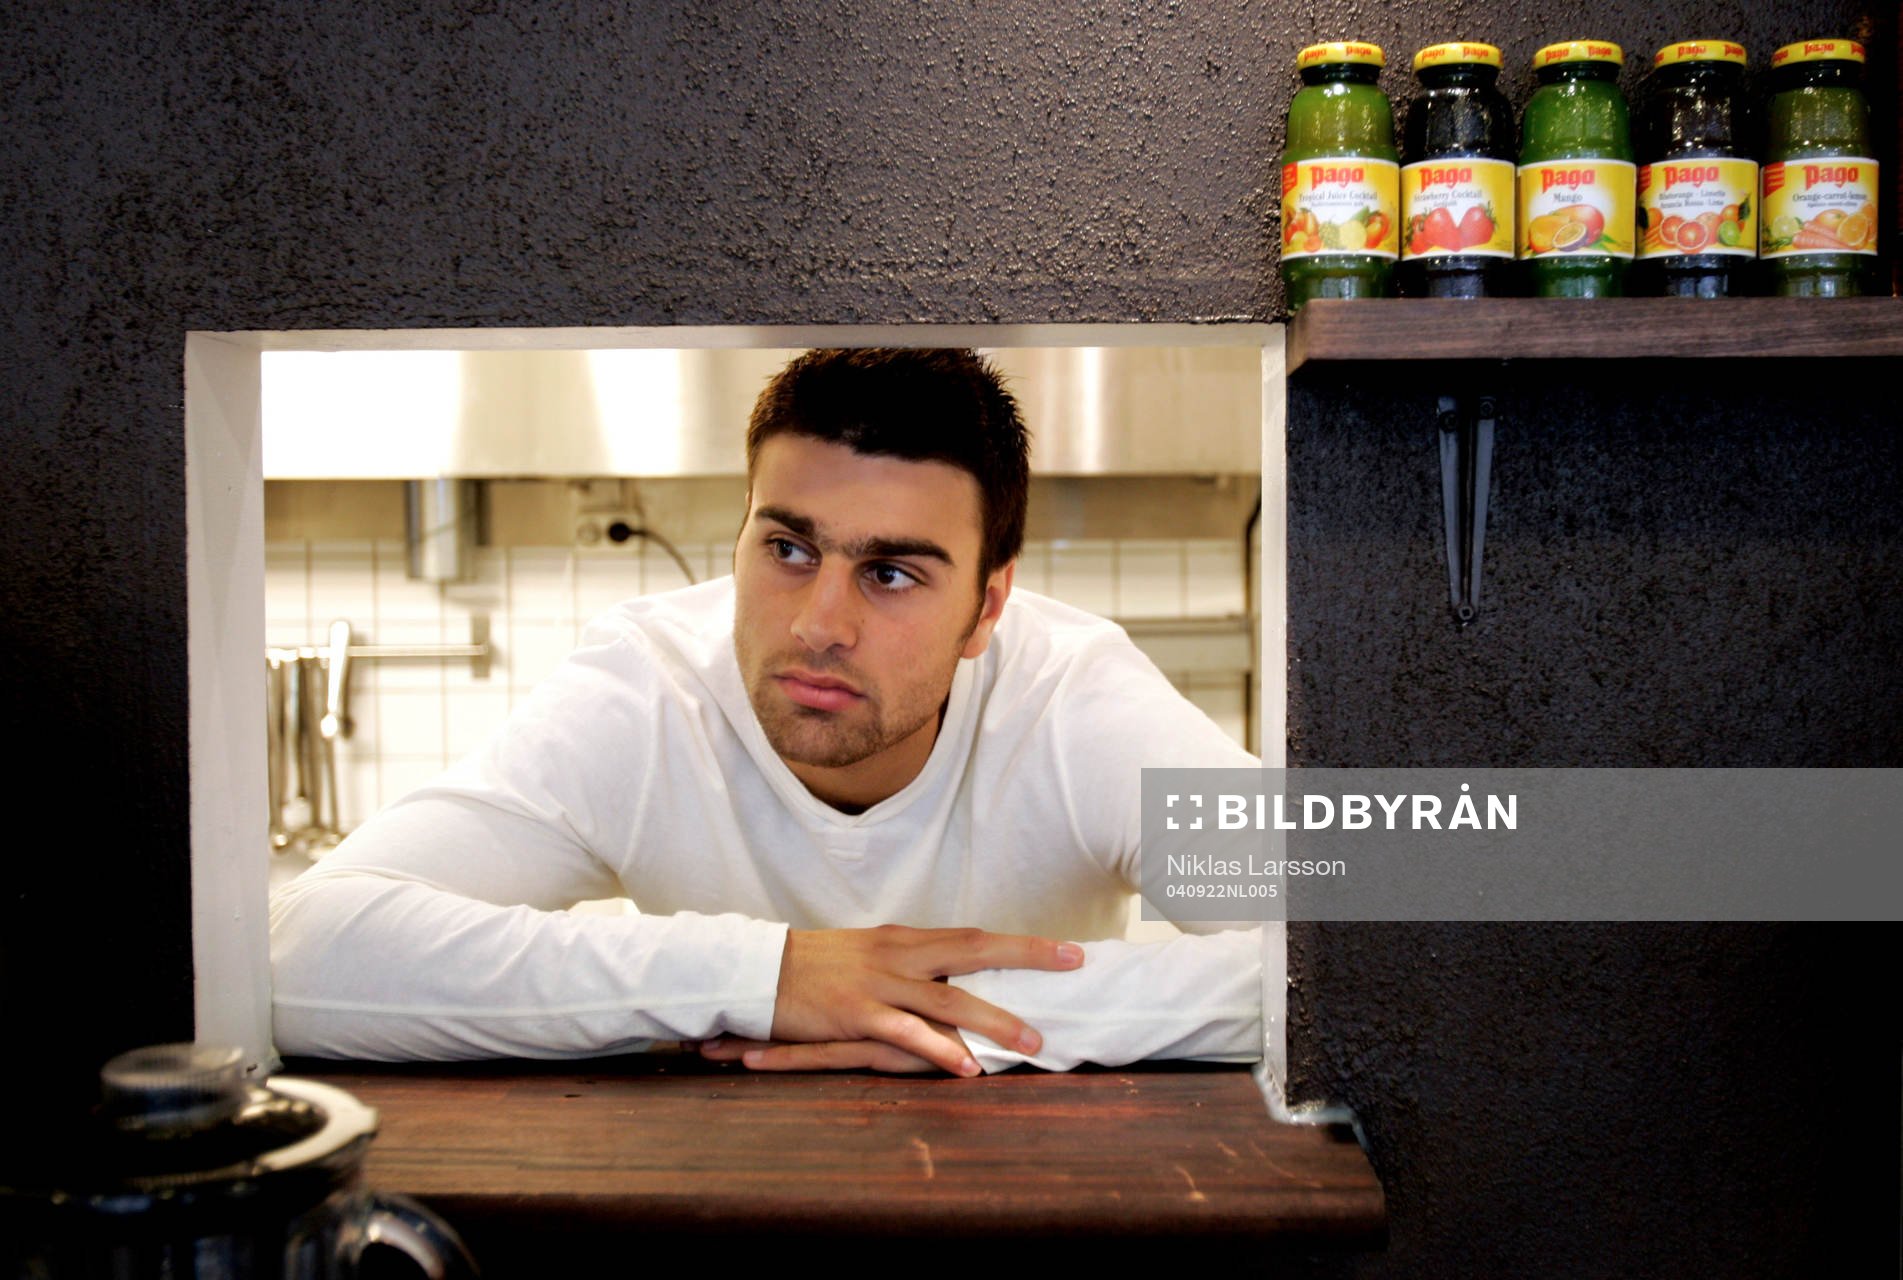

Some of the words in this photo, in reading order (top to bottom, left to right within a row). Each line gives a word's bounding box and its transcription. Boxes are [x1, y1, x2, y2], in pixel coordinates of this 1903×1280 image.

[1310, 165, 1364, 191] pago
[1419, 167, 1472, 192] pago
[1540, 168, 1595, 194] pago
[1663, 166, 1719, 191] pago
[1802, 165, 1859, 191] pago
[1349, 190, 1378, 200] Cocktail
[1451, 189, 1483, 199] Cocktail
[1553, 192, 1583, 203] Mango
